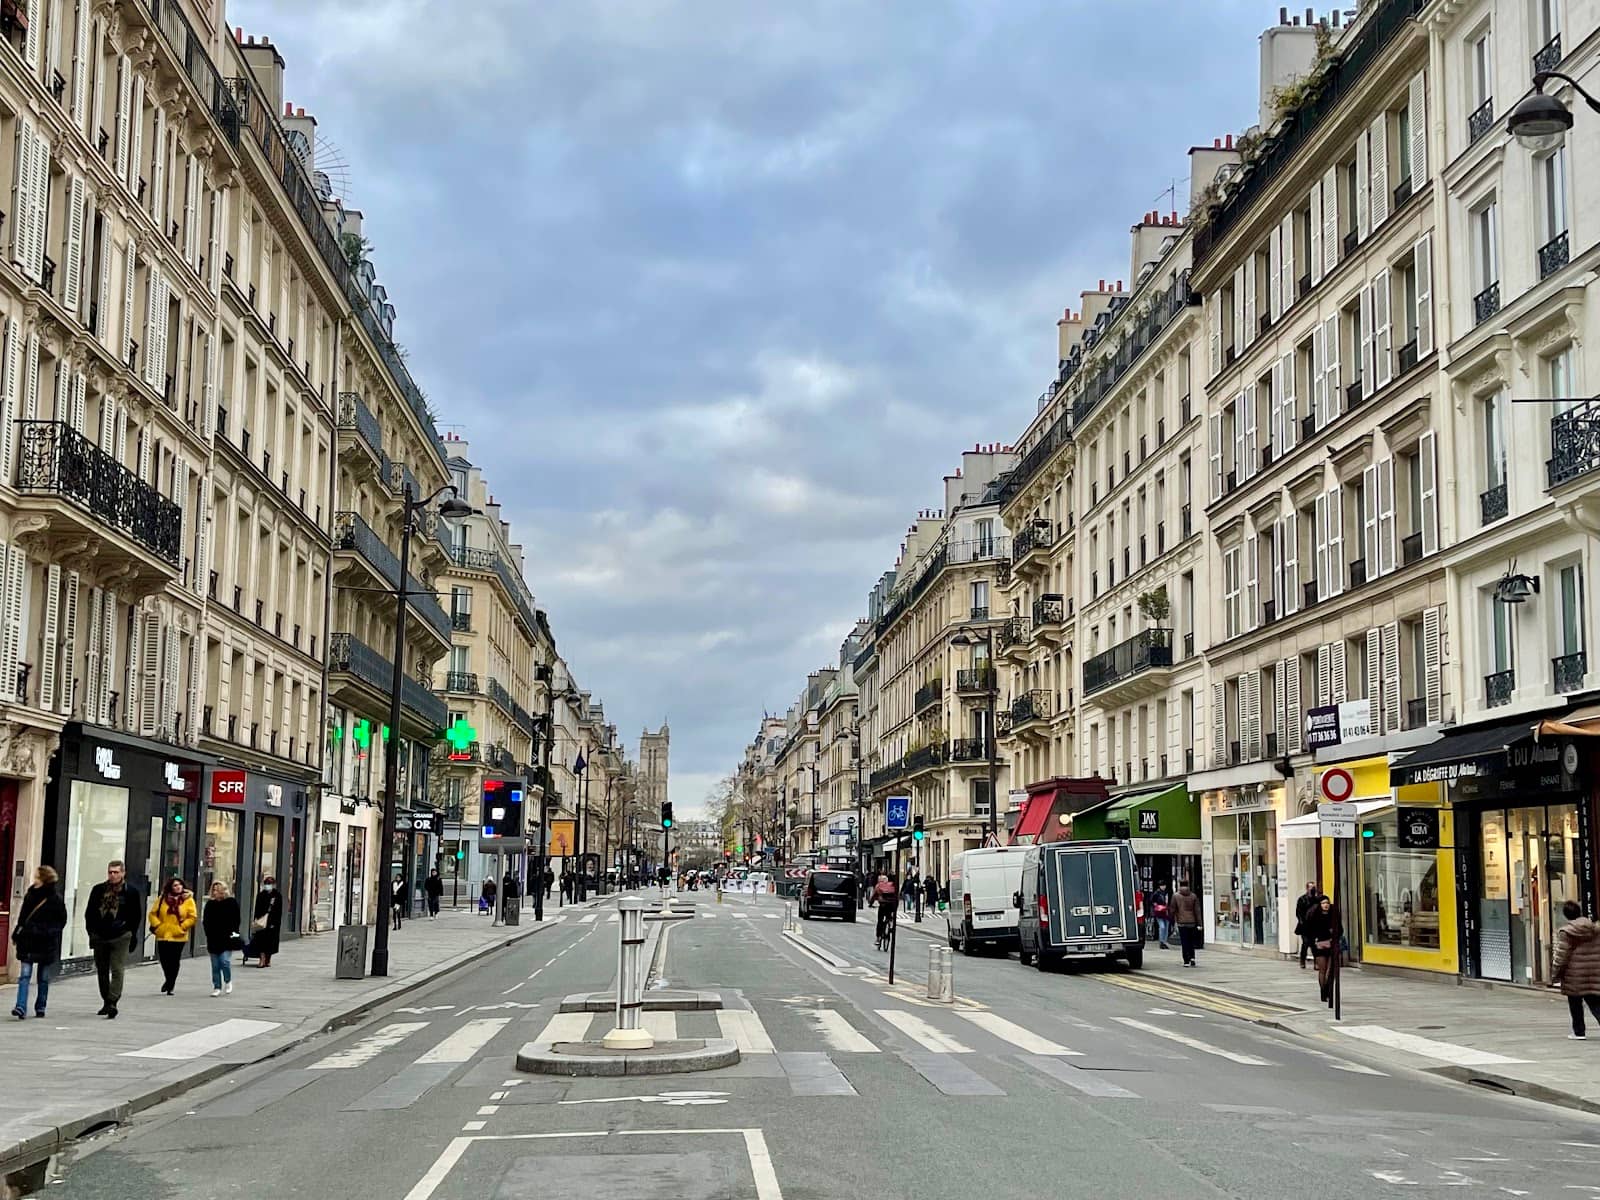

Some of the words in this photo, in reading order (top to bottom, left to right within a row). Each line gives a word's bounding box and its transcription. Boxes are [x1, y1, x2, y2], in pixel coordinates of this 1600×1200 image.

[1414, 770, 1422, 783] LA
[1422, 765, 1448, 782] DÉGRIFFE
[1448, 764, 1458, 778] DU
[218, 781, 244, 793] SFR
[413, 819, 432, 830] OR
[1141, 812, 1157, 825] JAK
